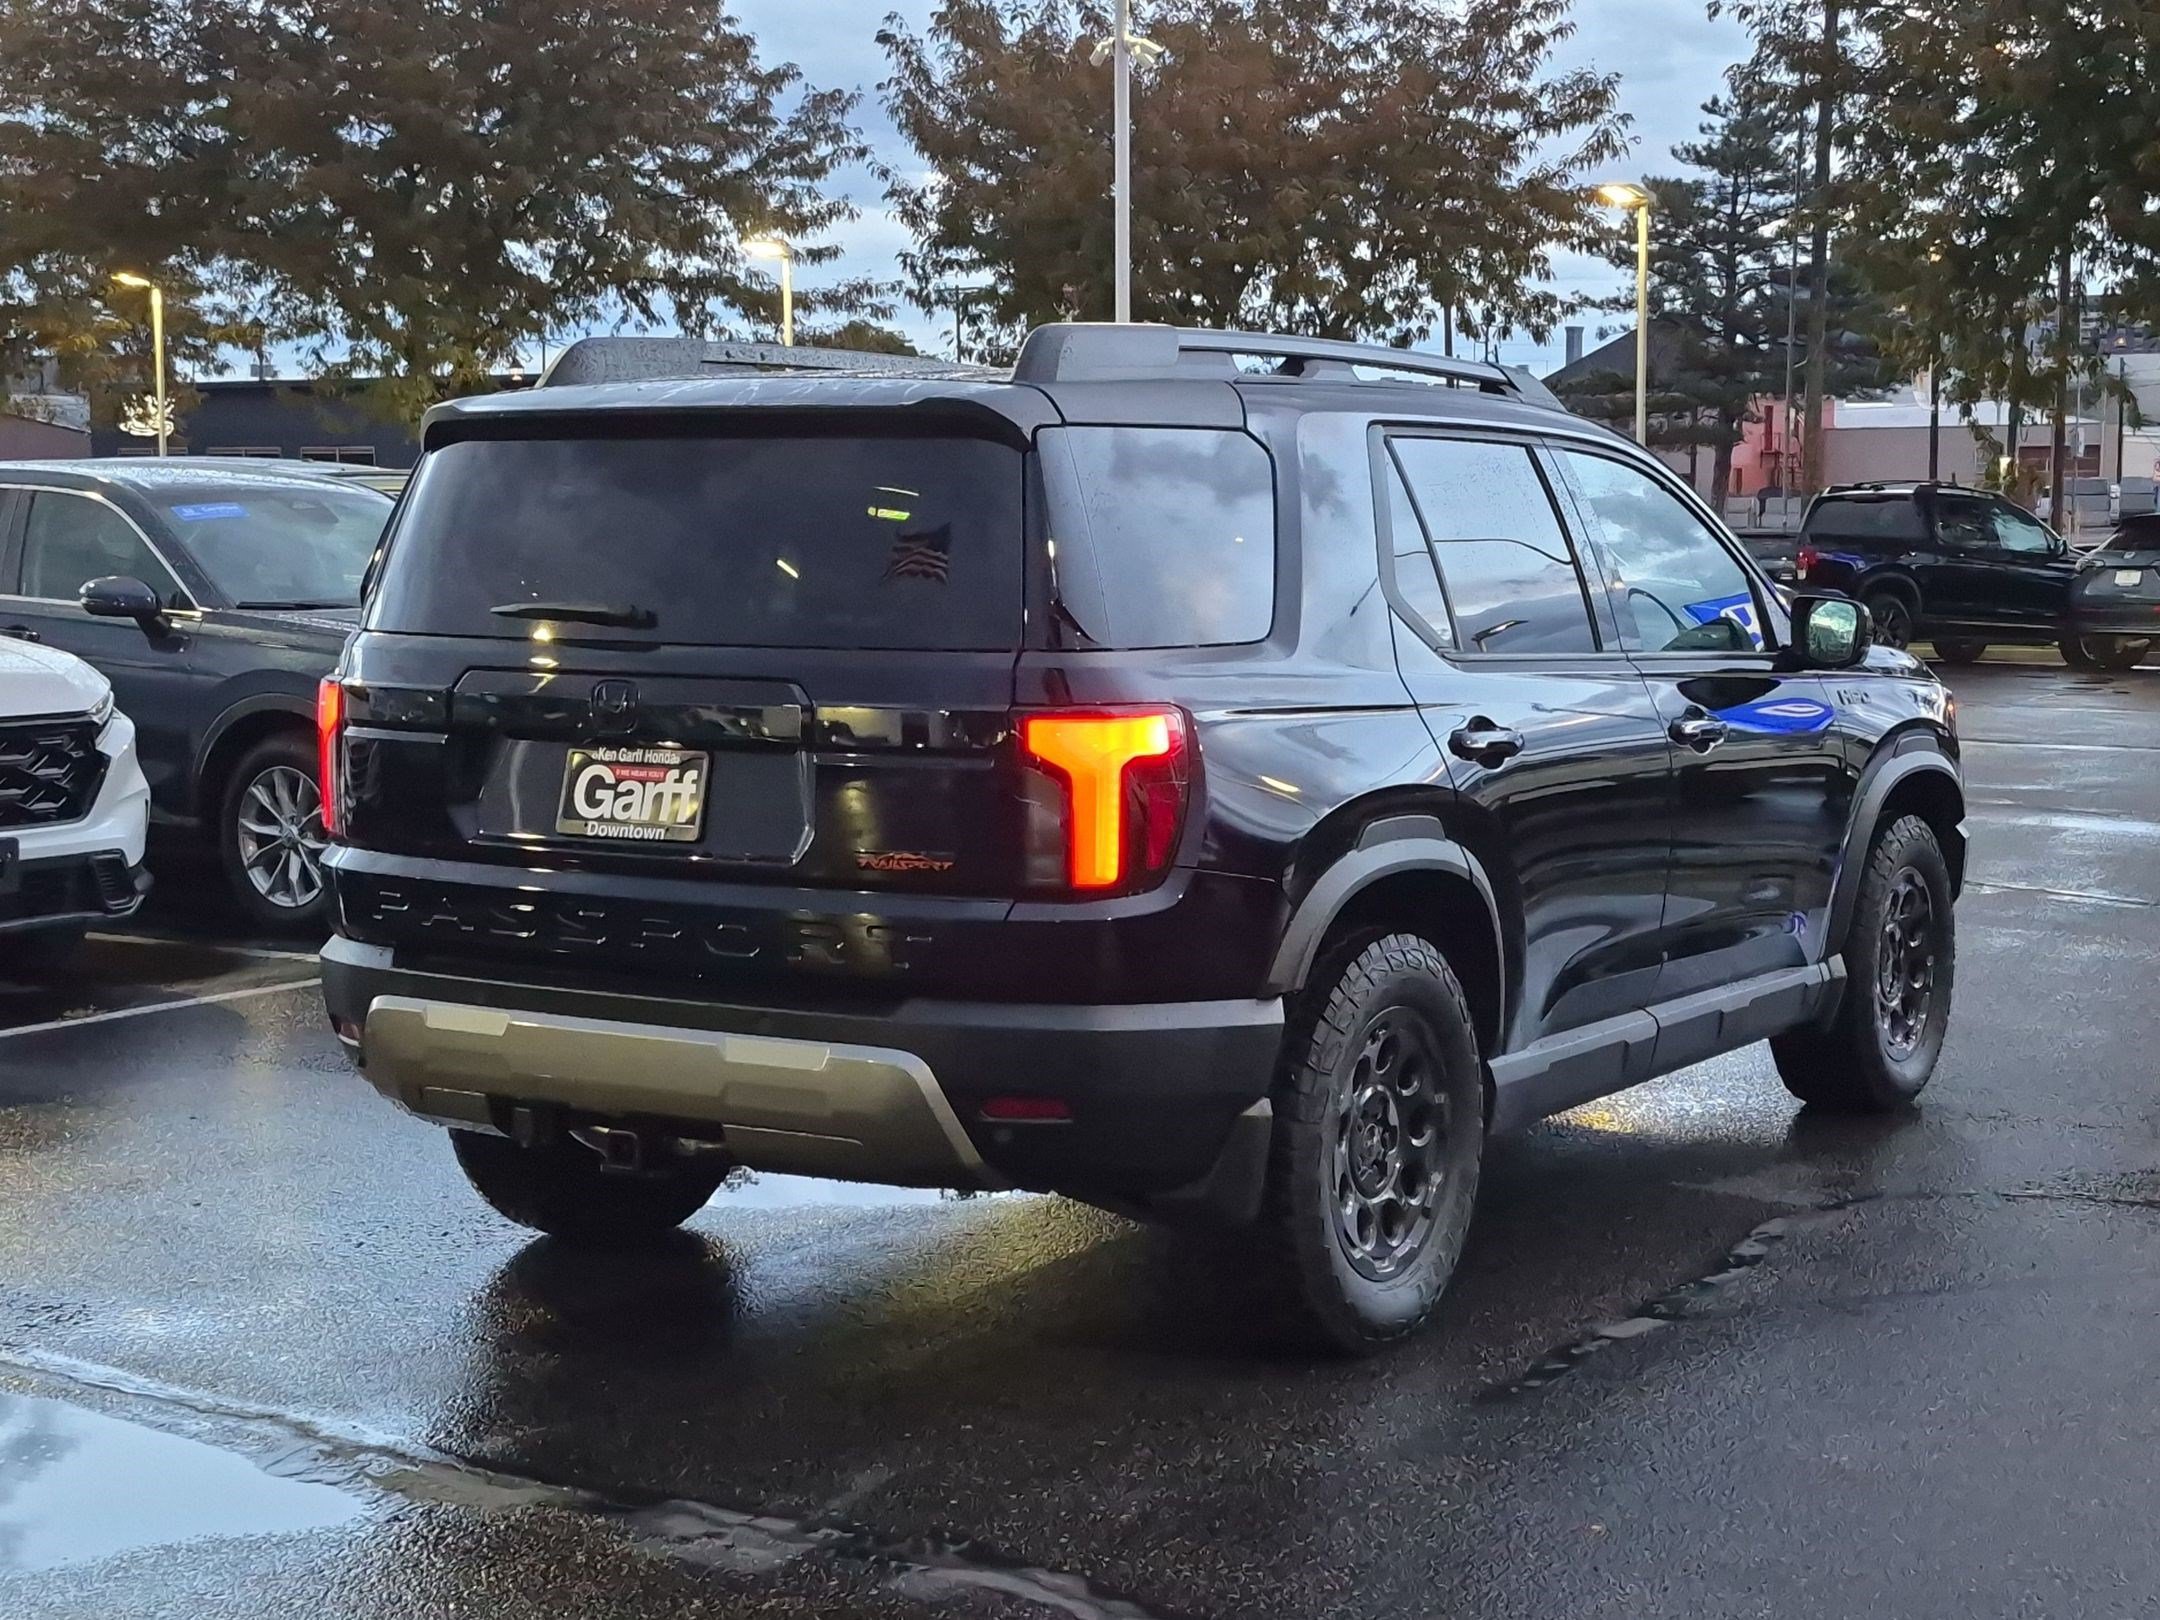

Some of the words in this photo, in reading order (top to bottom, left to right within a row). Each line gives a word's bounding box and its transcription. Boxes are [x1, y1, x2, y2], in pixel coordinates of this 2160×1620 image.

[598, 747, 617, 761] Ken
[619, 747, 643, 764] Garff
[644, 748, 678, 765] Honda
[573, 764, 698, 823] Garff
[587, 820, 666, 840] Downtown
[373, 891, 933, 968] PASSPORT
